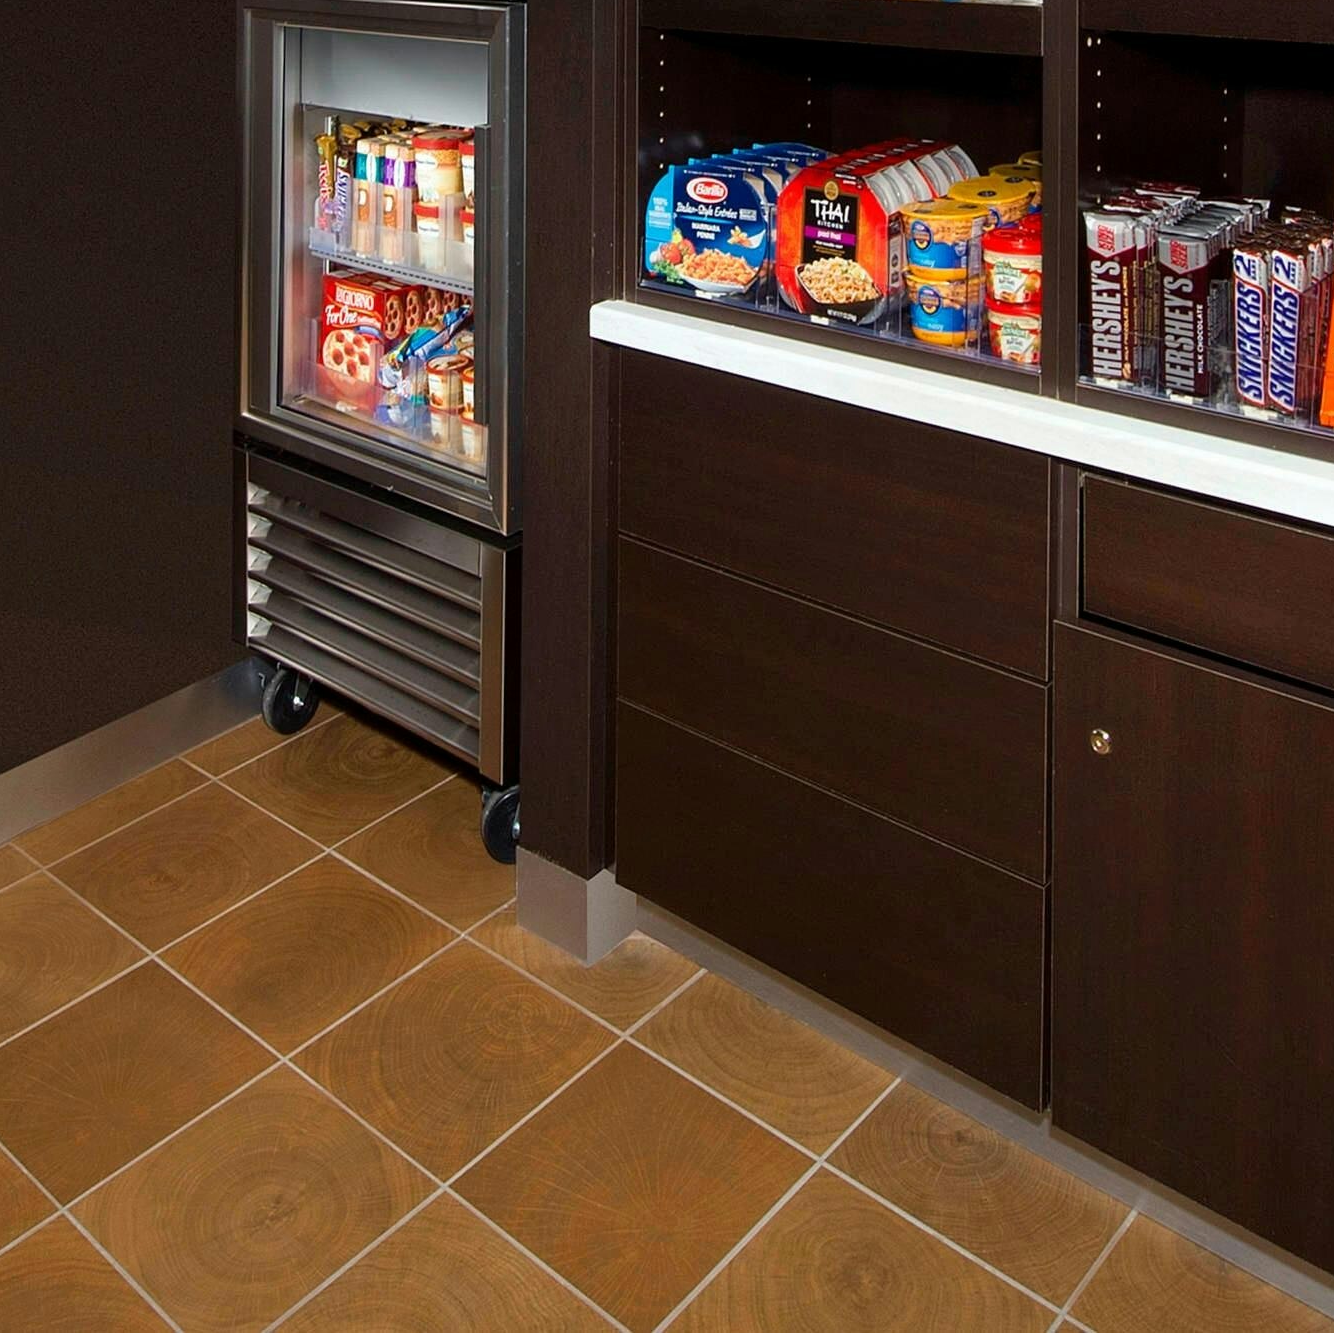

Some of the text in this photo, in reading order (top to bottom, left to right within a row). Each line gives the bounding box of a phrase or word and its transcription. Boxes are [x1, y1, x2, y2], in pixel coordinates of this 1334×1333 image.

[810, 198, 850, 223] THAI
[817, 221, 844, 229] KITCHEN
[1235, 255, 1251, 278] 2
[1274, 257, 1291, 280] 2
[1091, 260, 1122, 377] HERSHEY'S
[1163, 275, 1196, 392] HERSHEY'S
[1196, 304, 1204, 353] CHOCOLATE
[1235, 282, 1264, 402] SNICKERS
[1269, 285, 1299, 407] SNICKERS
